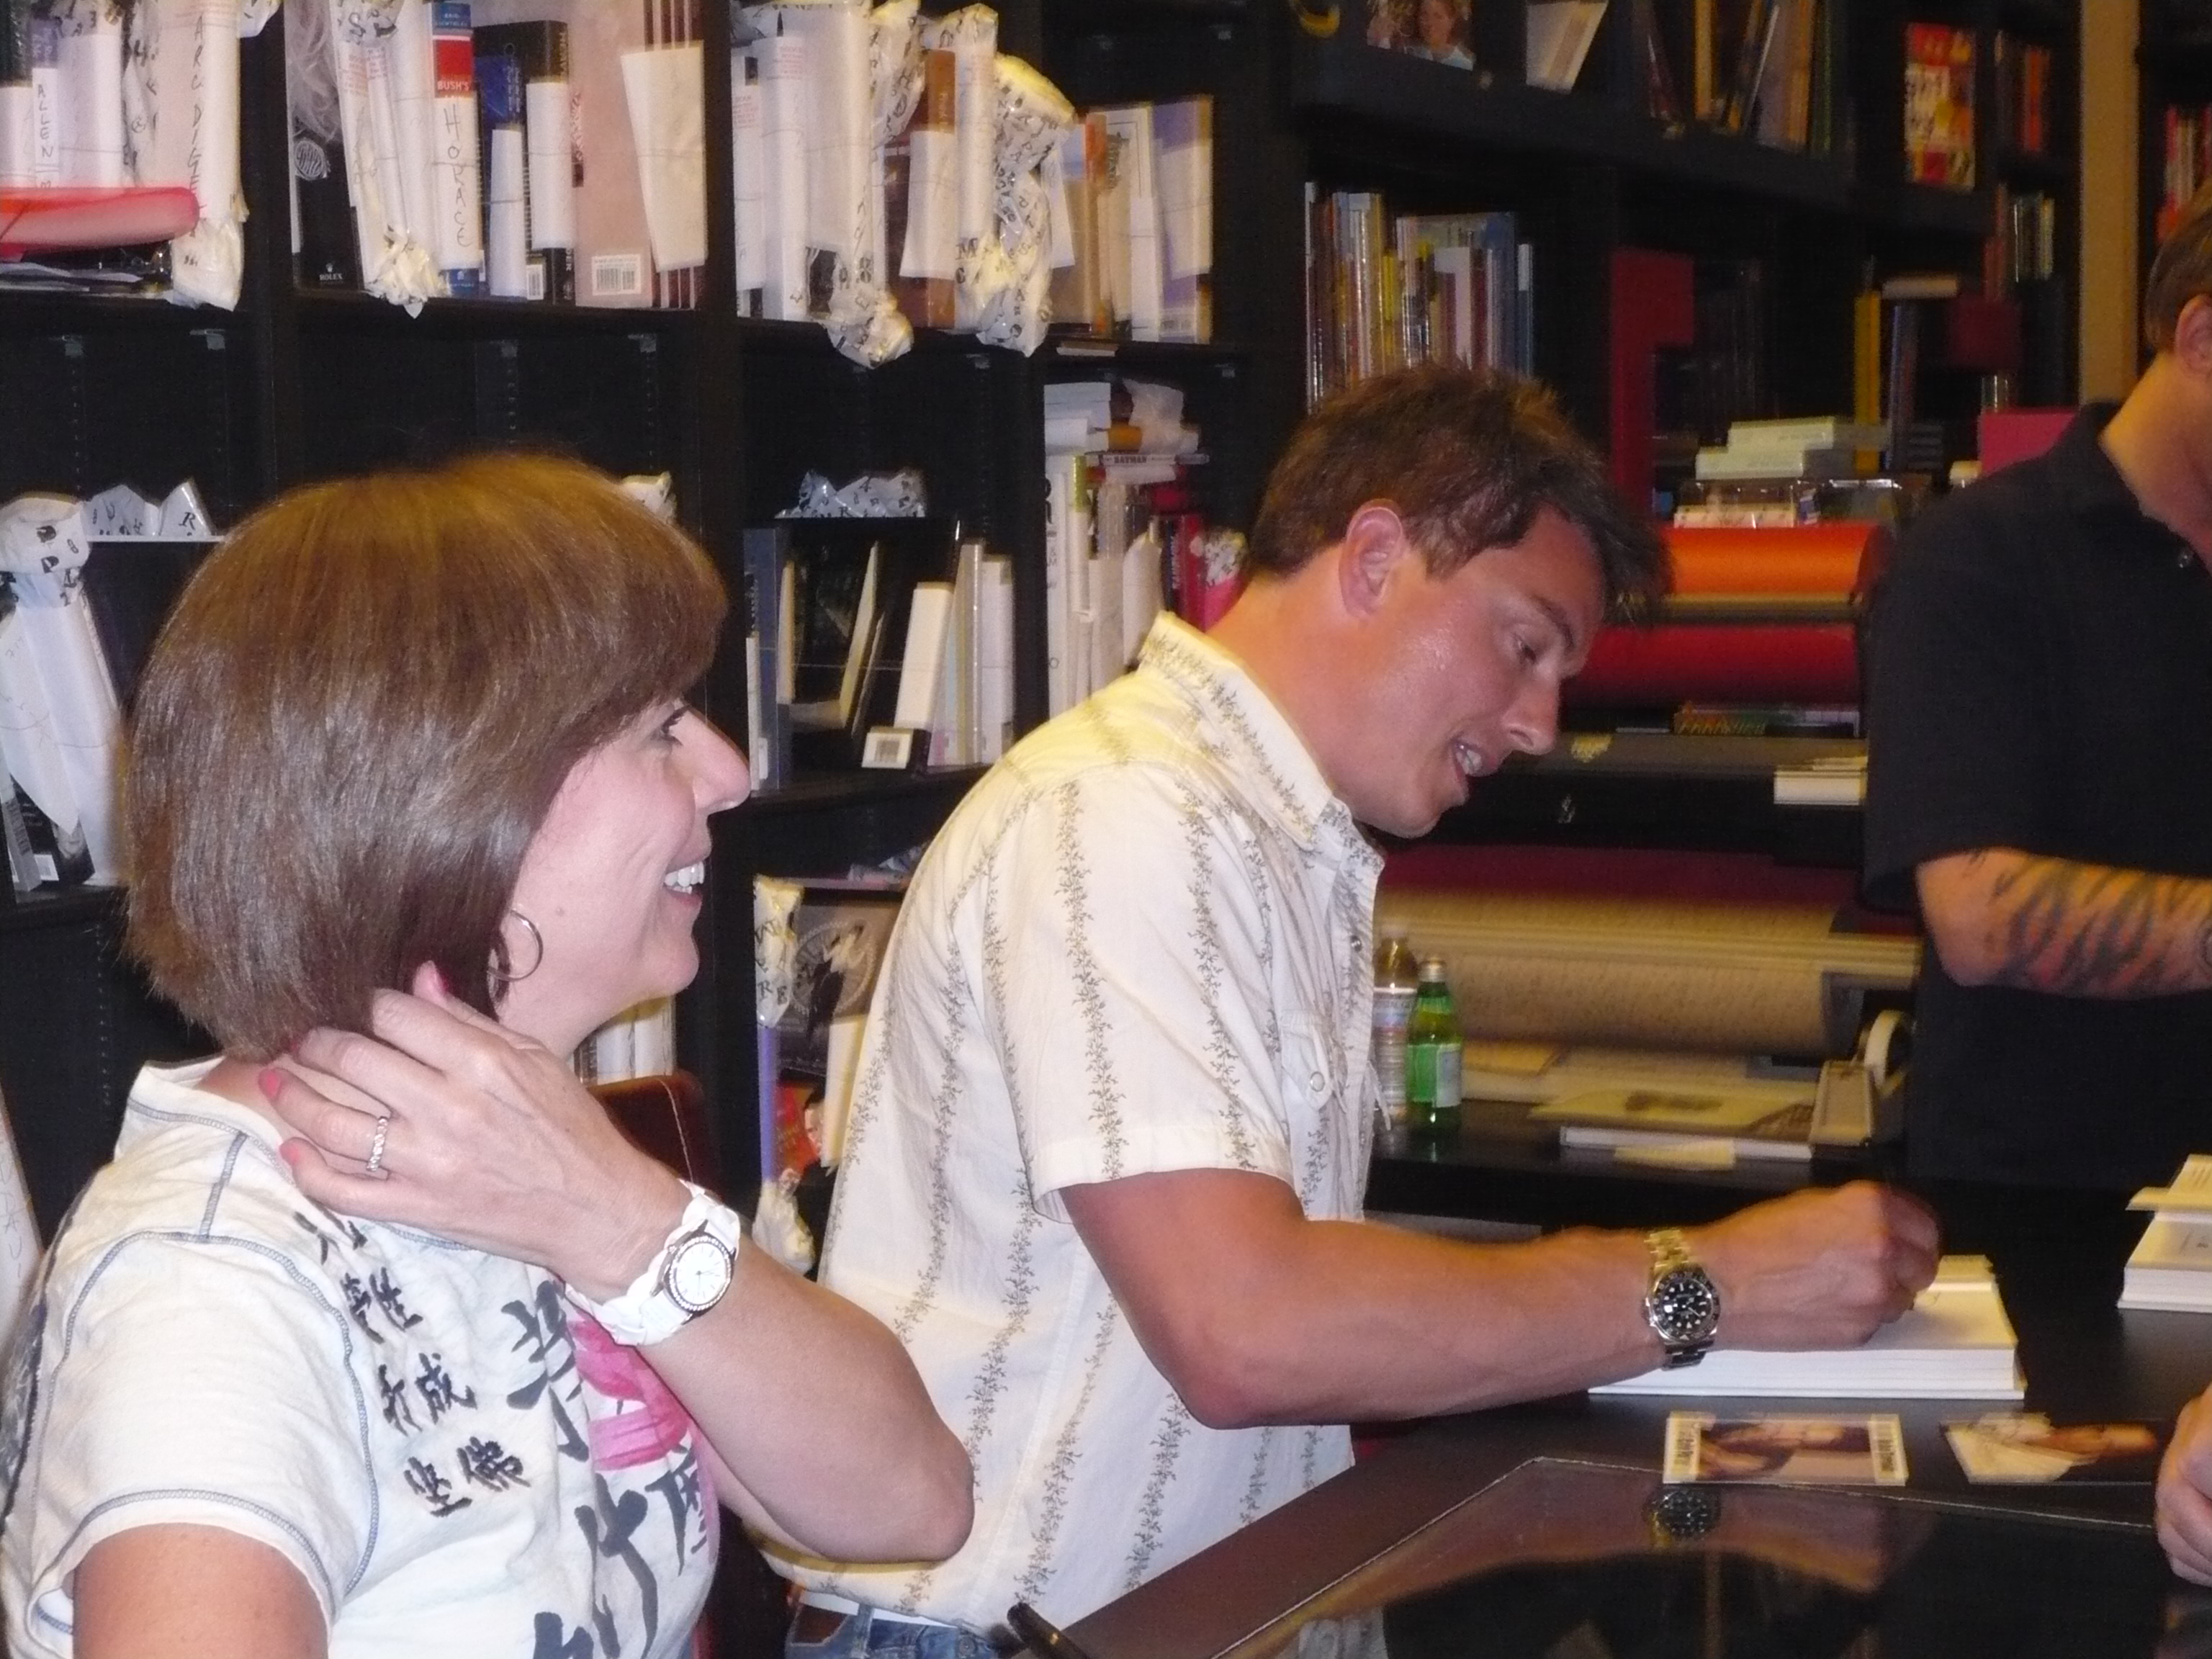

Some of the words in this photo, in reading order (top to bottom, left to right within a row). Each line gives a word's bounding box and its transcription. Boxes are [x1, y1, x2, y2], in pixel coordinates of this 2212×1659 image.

[436, 80, 470, 91] BUSH'S
[37, 84, 54, 158] ALLEN
[443, 103, 473, 248] HORACE
[1113, 456, 1148, 464] BATMAN
